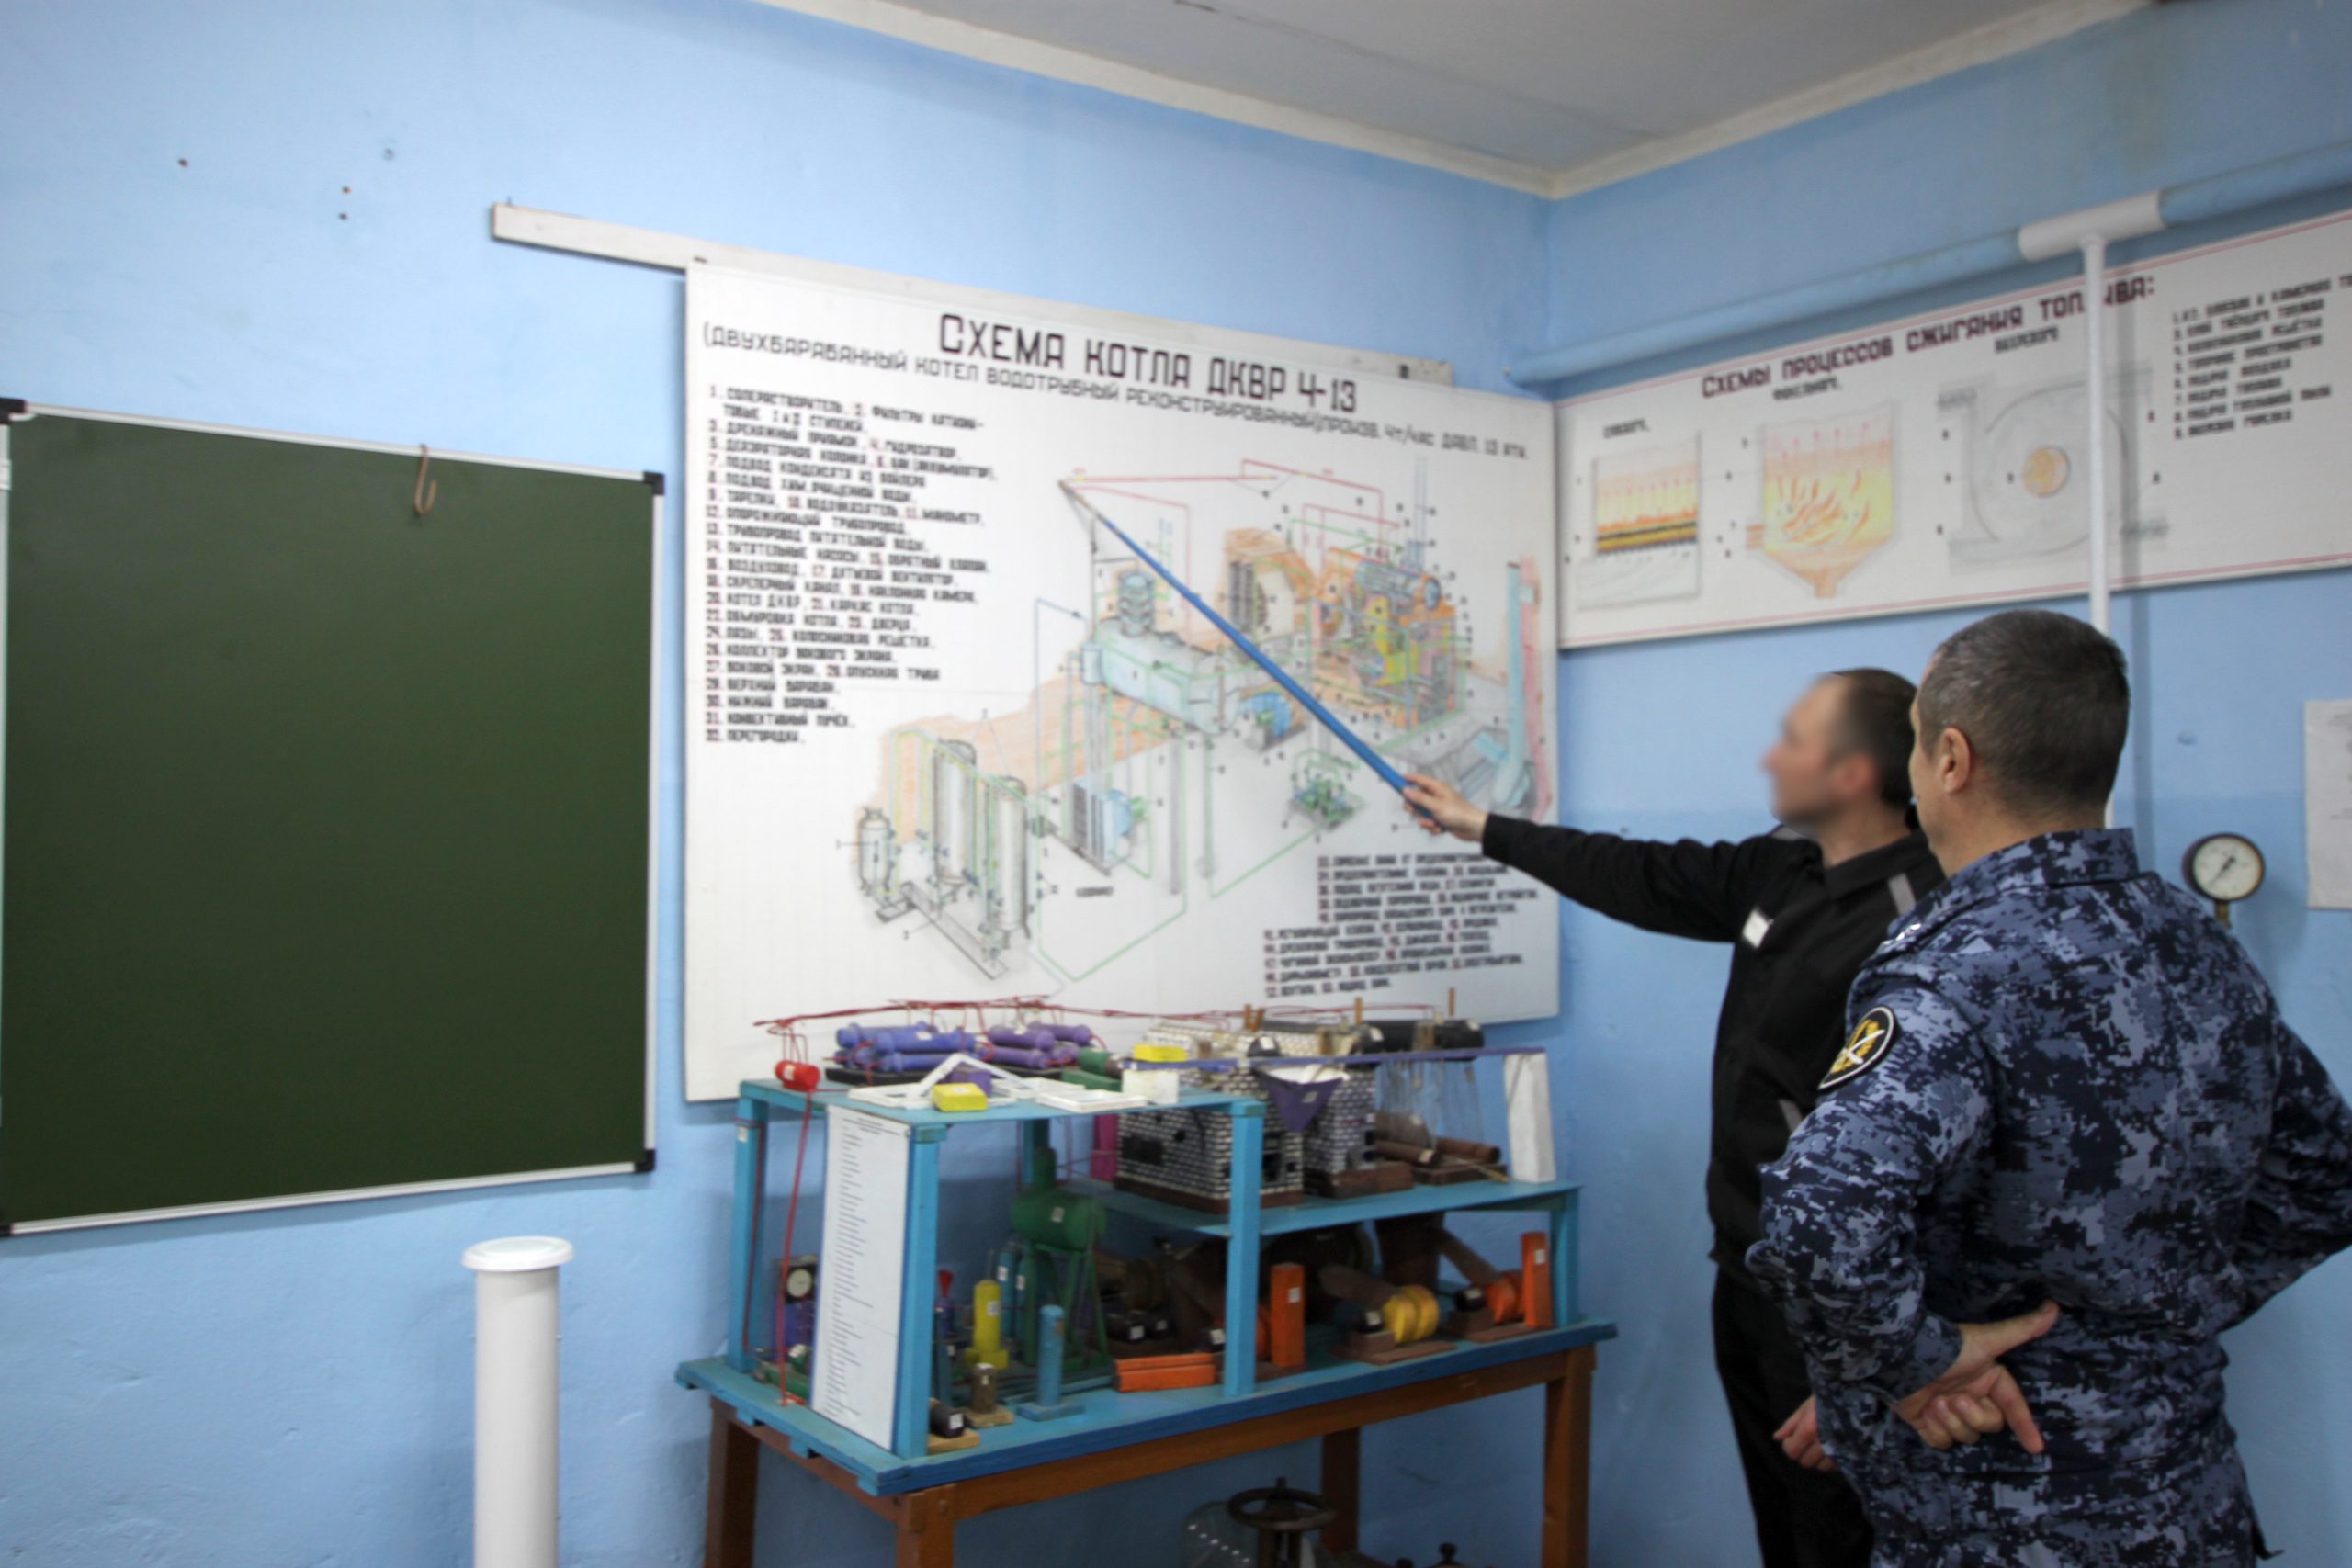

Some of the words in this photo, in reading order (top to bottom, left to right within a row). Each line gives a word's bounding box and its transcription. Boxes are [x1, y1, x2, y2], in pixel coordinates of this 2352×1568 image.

[914, 357, 978, 381] КОТЕЛ
[986, 367, 1120, 401] ВОДОТРУБНЫЙ
[940, 313, 1064, 369] СХЕМА
[1085, 339, 1191, 388] КОТЛА
[1207, 356, 1286, 400] ДКВР
[1297, 371, 1356, 413] 4-13
[1702, 365, 1770, 398] СХЕМЫ
[1781, 335, 1893, 378] ПРОЦЕССОВ
[1906, 304, 2023, 352] СЖИГАНИЯ
[2038, 275, 2154, 321] ТОПИВА:
